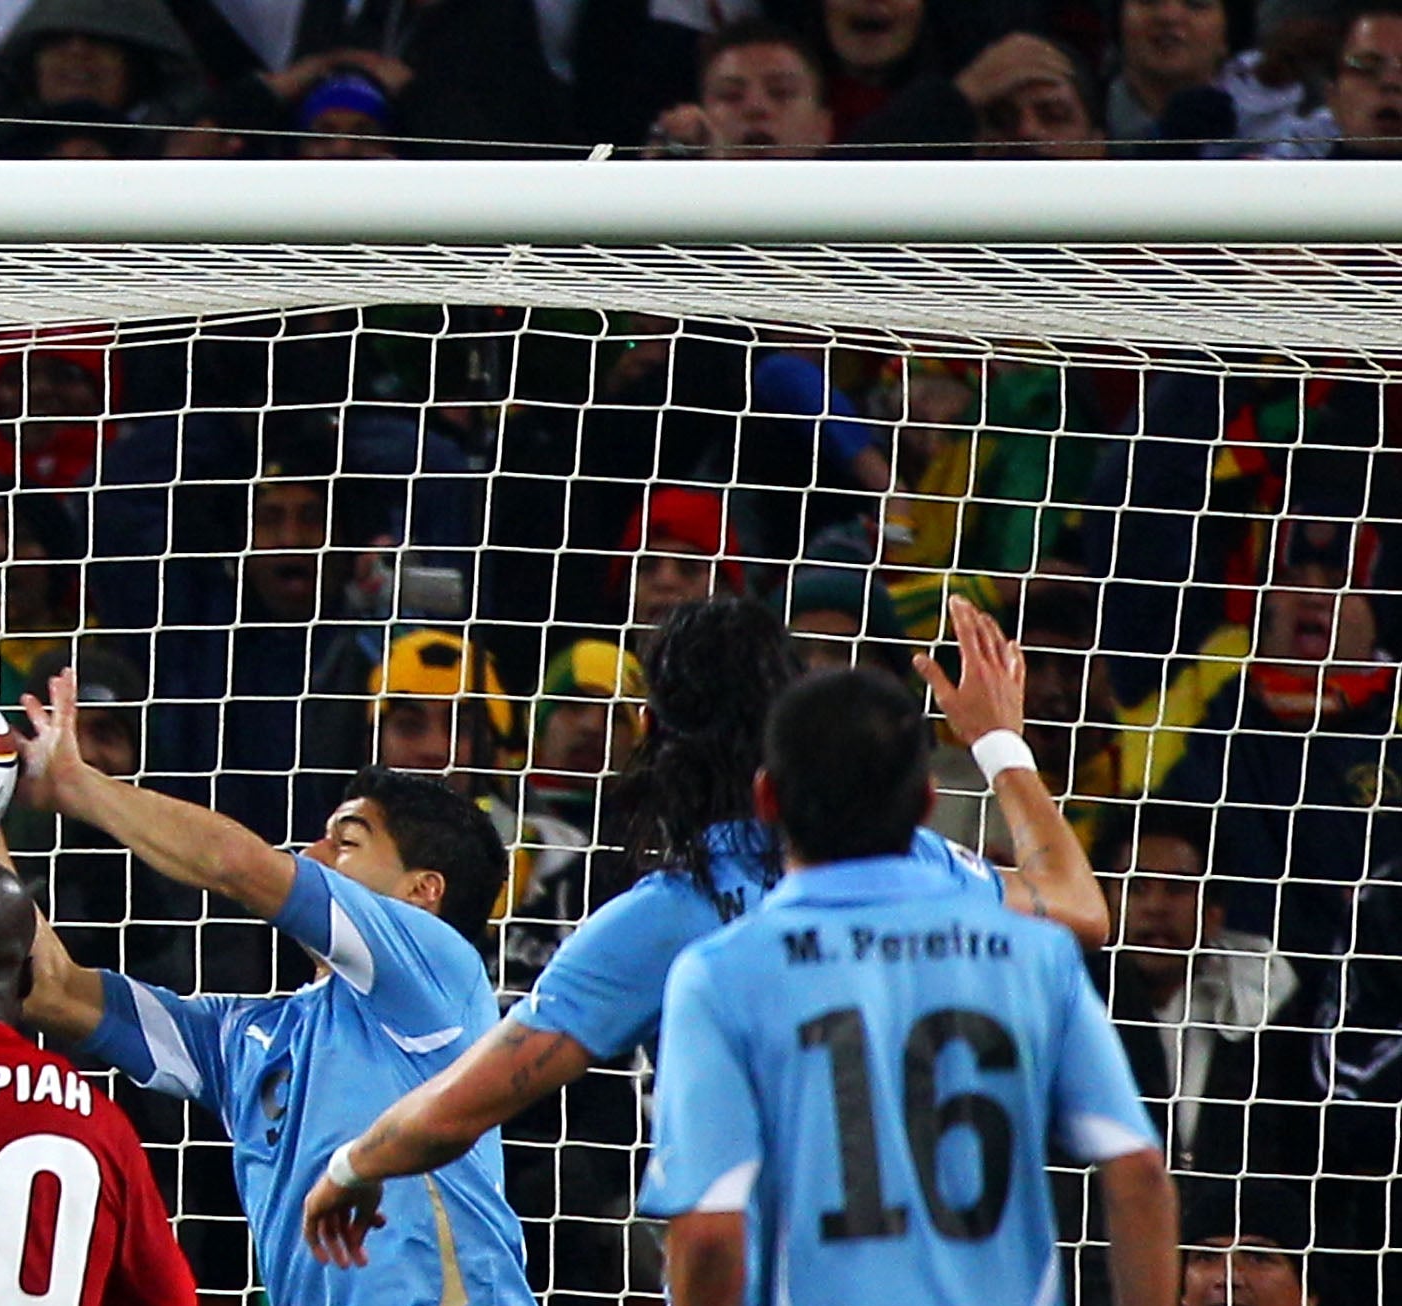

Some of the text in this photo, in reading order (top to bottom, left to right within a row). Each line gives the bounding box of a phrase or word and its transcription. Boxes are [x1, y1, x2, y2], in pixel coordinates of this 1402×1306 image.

[784, 919, 1010, 965] M. Pereira
[797, 1004, 1020, 1243] 16
